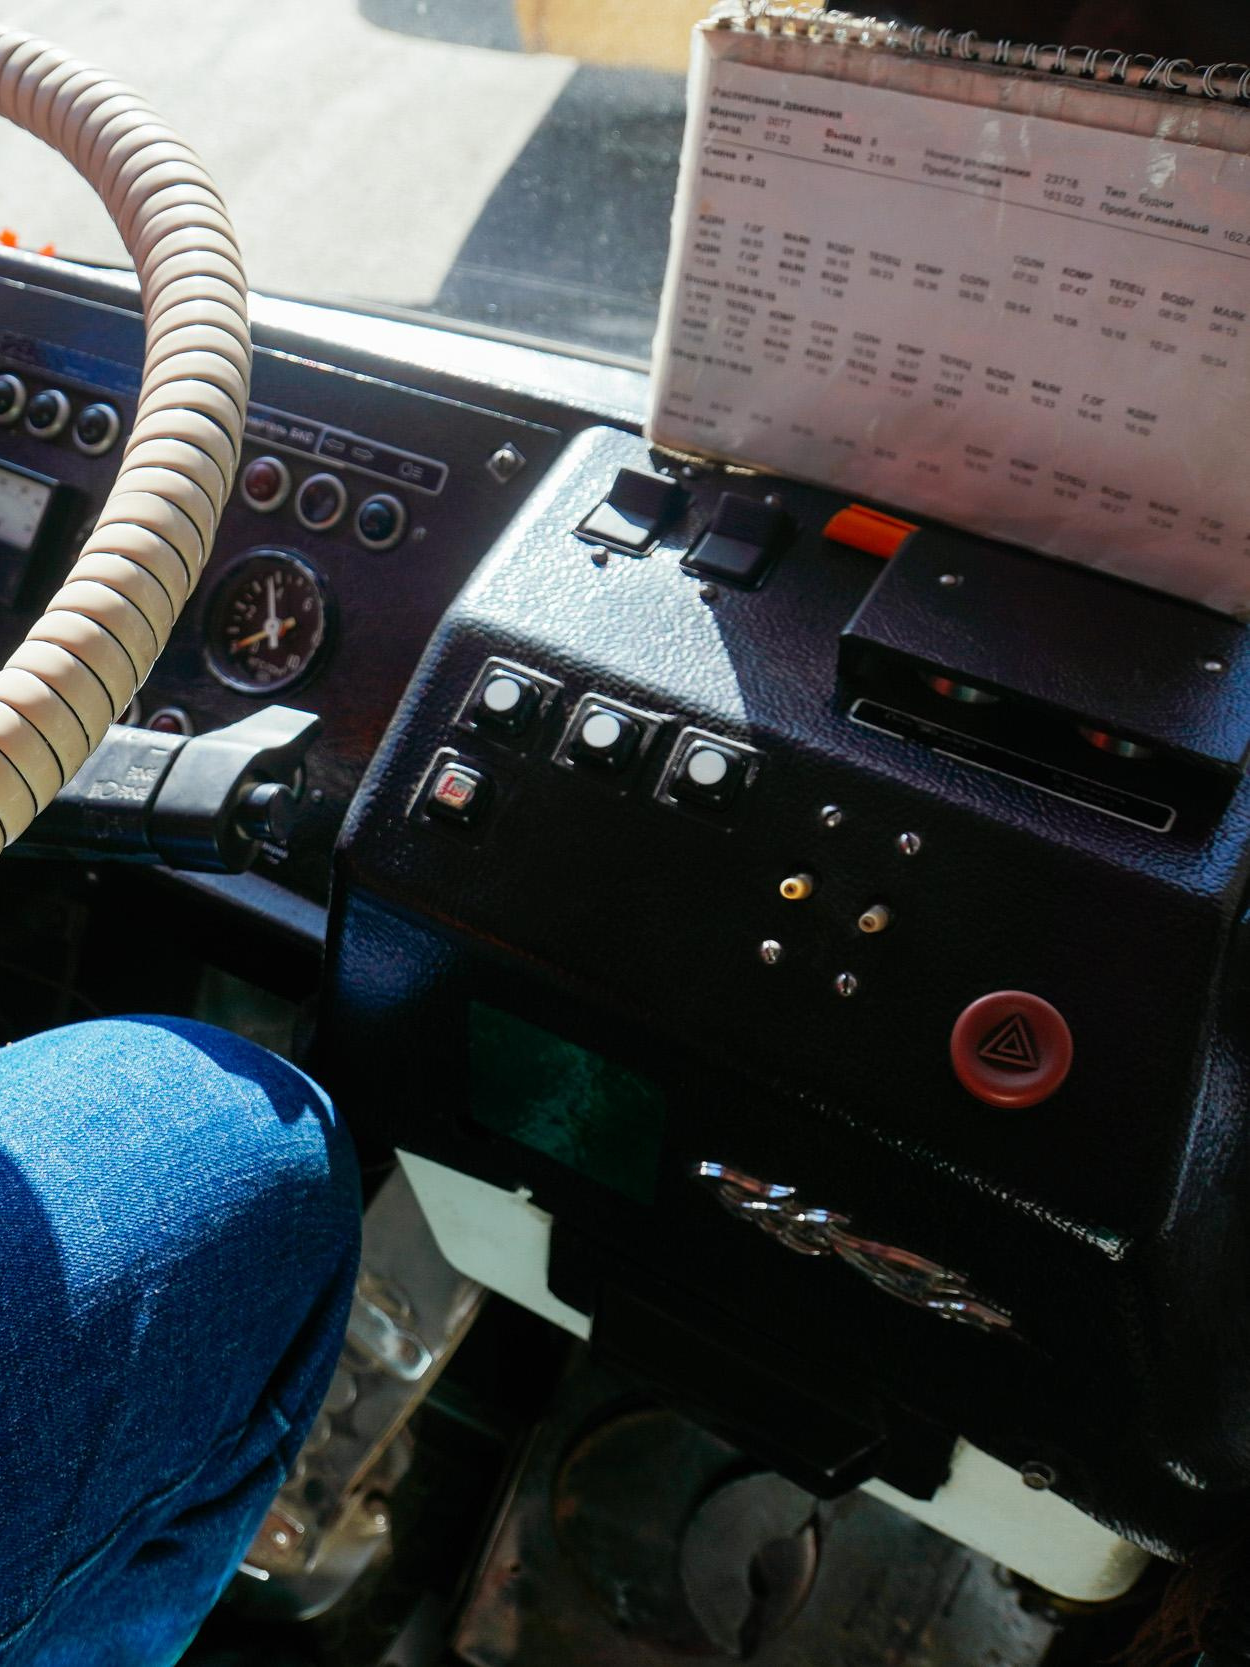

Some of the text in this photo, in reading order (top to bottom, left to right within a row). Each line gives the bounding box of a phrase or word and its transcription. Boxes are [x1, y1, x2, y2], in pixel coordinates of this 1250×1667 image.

[1104, 184, 1128, 200] Тип
[1137, 192, 1176, 210] Будни
[1098, 201, 1144, 220] Пробег
[1144, 213, 1211, 236] линейный
[1108, 277, 1147, 298] ТЕЛЕЦ
[1211, 304, 1248, 323] МАЯК
